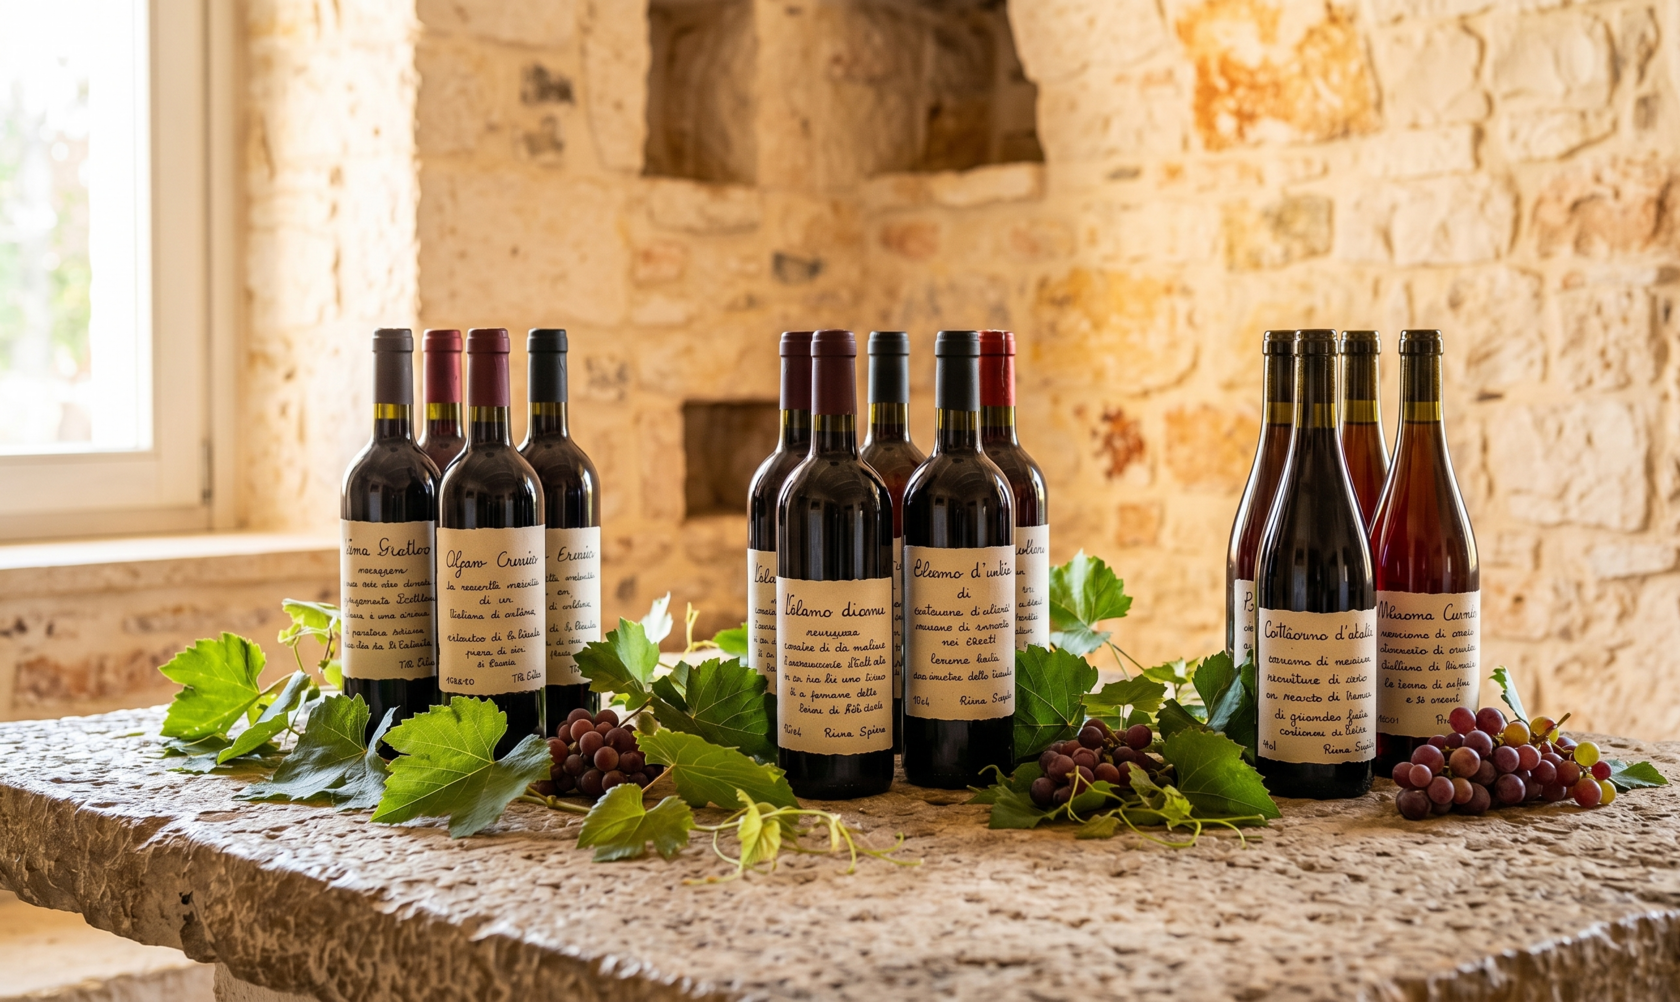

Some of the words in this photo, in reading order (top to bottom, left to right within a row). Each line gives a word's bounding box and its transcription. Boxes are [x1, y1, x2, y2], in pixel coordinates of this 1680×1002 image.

[957, 586, 971, 598] di
[479, 595, 491, 605] di
[491, 609, 501, 619] di
[971, 606, 980, 616] di
[549, 623, 559, 632] di
[959, 622, 970, 632] di
[491, 632, 502, 642] di
[1435, 628, 1446, 639] di
[497, 647, 507, 655] di
[819, 642, 830, 652] di
[1433, 645, 1444, 655] di
[1316, 656, 1329, 666] di
[1429, 661, 1440, 671] di
[1328, 674, 1340, 684] di
[1432, 679, 1442, 689] di
[1328, 692, 1340, 701] di
[829, 705, 840, 714] di
[1275, 708, 1285, 719] di
